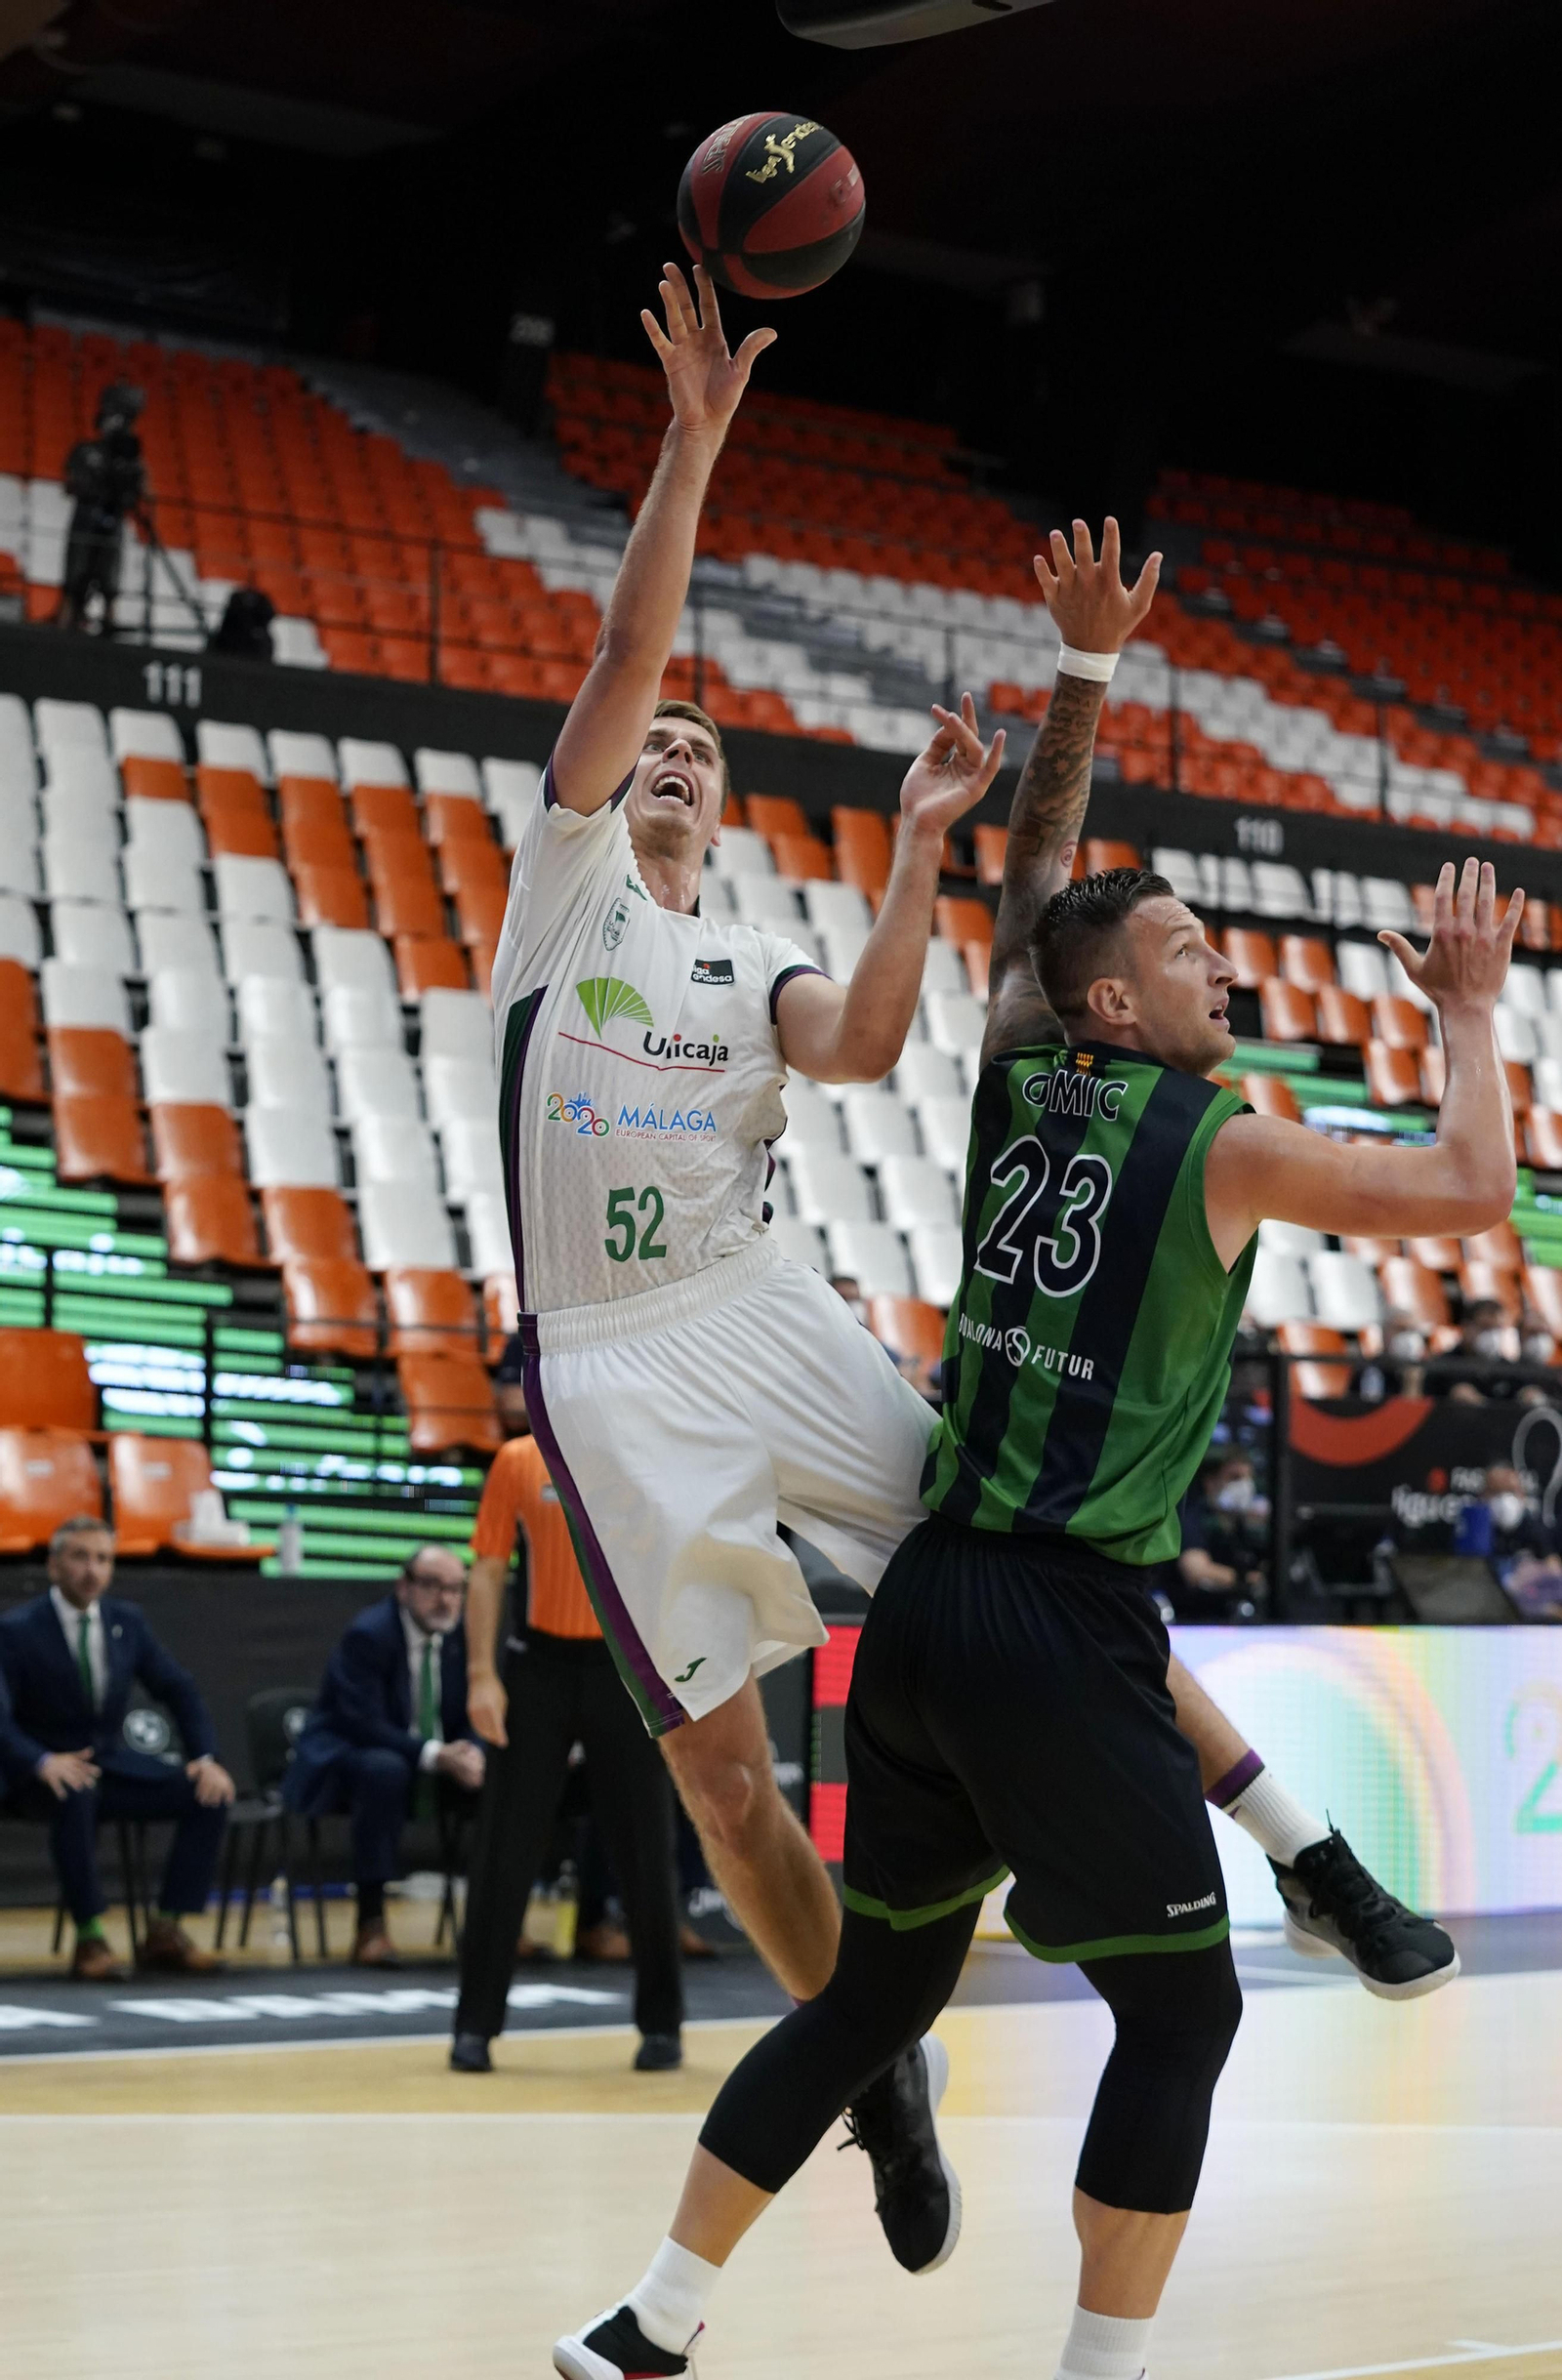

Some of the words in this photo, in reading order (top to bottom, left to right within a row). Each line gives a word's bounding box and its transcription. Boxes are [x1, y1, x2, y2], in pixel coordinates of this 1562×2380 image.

[142, 660, 203, 709] 111
[1234, 816, 1285, 856] 110
[692, 973, 733, 983] endesa
[547, 1092, 610, 1137] 2020
[617, 1103, 717, 1131] MÁLAGA
[1022, 1069, 1129, 1122] OMIC
[616, 1129, 656, 1140] EUROPEAN
[658, 1132, 686, 1142] CAPITAL
[604, 1185, 668, 1263] 52
[974, 1134, 1113, 1298] 23
[1031, 1343, 1095, 1381] FUTUR
[1166, 1891, 1217, 1918] SPALDING
